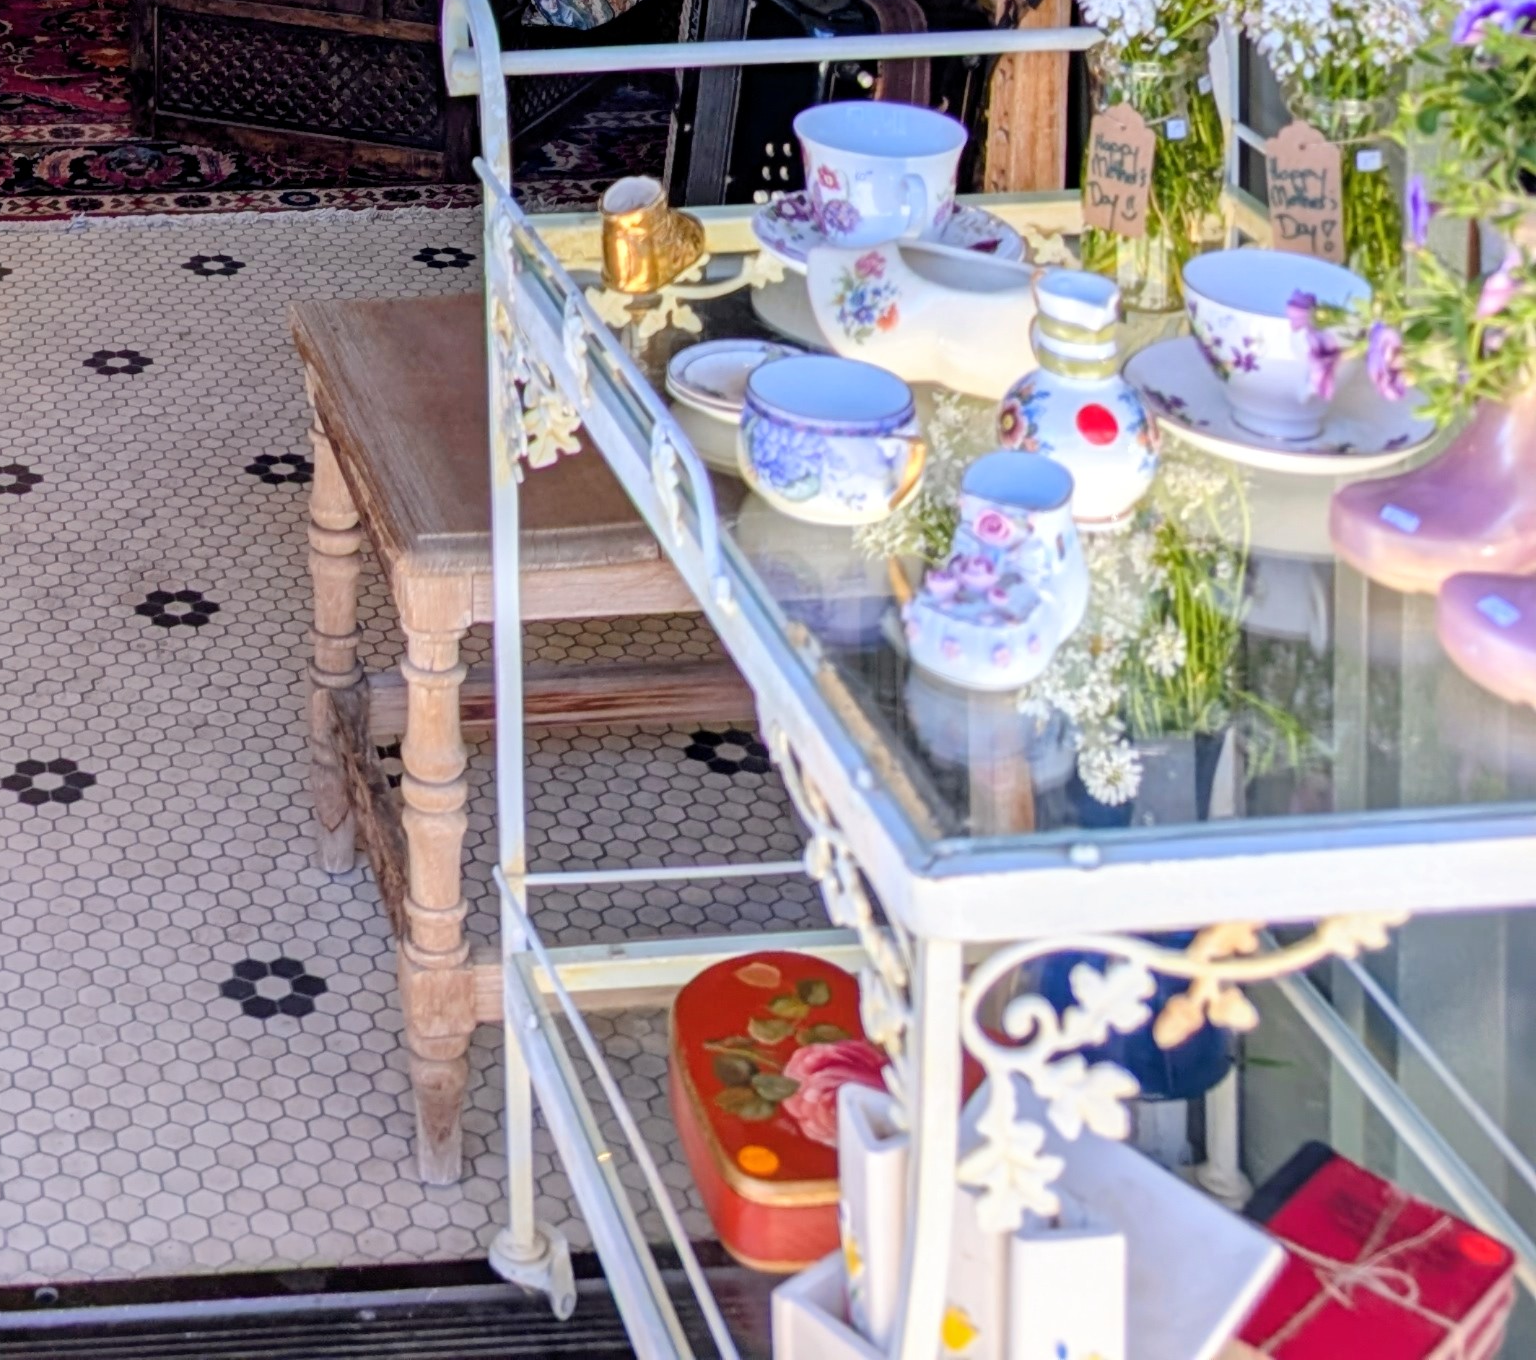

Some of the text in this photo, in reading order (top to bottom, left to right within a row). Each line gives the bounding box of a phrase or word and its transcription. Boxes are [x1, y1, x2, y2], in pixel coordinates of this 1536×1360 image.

[1095, 133, 1139, 174] Happy
[1270, 156, 1327, 197] Happy
[1088, 181, 1119, 230] Day
